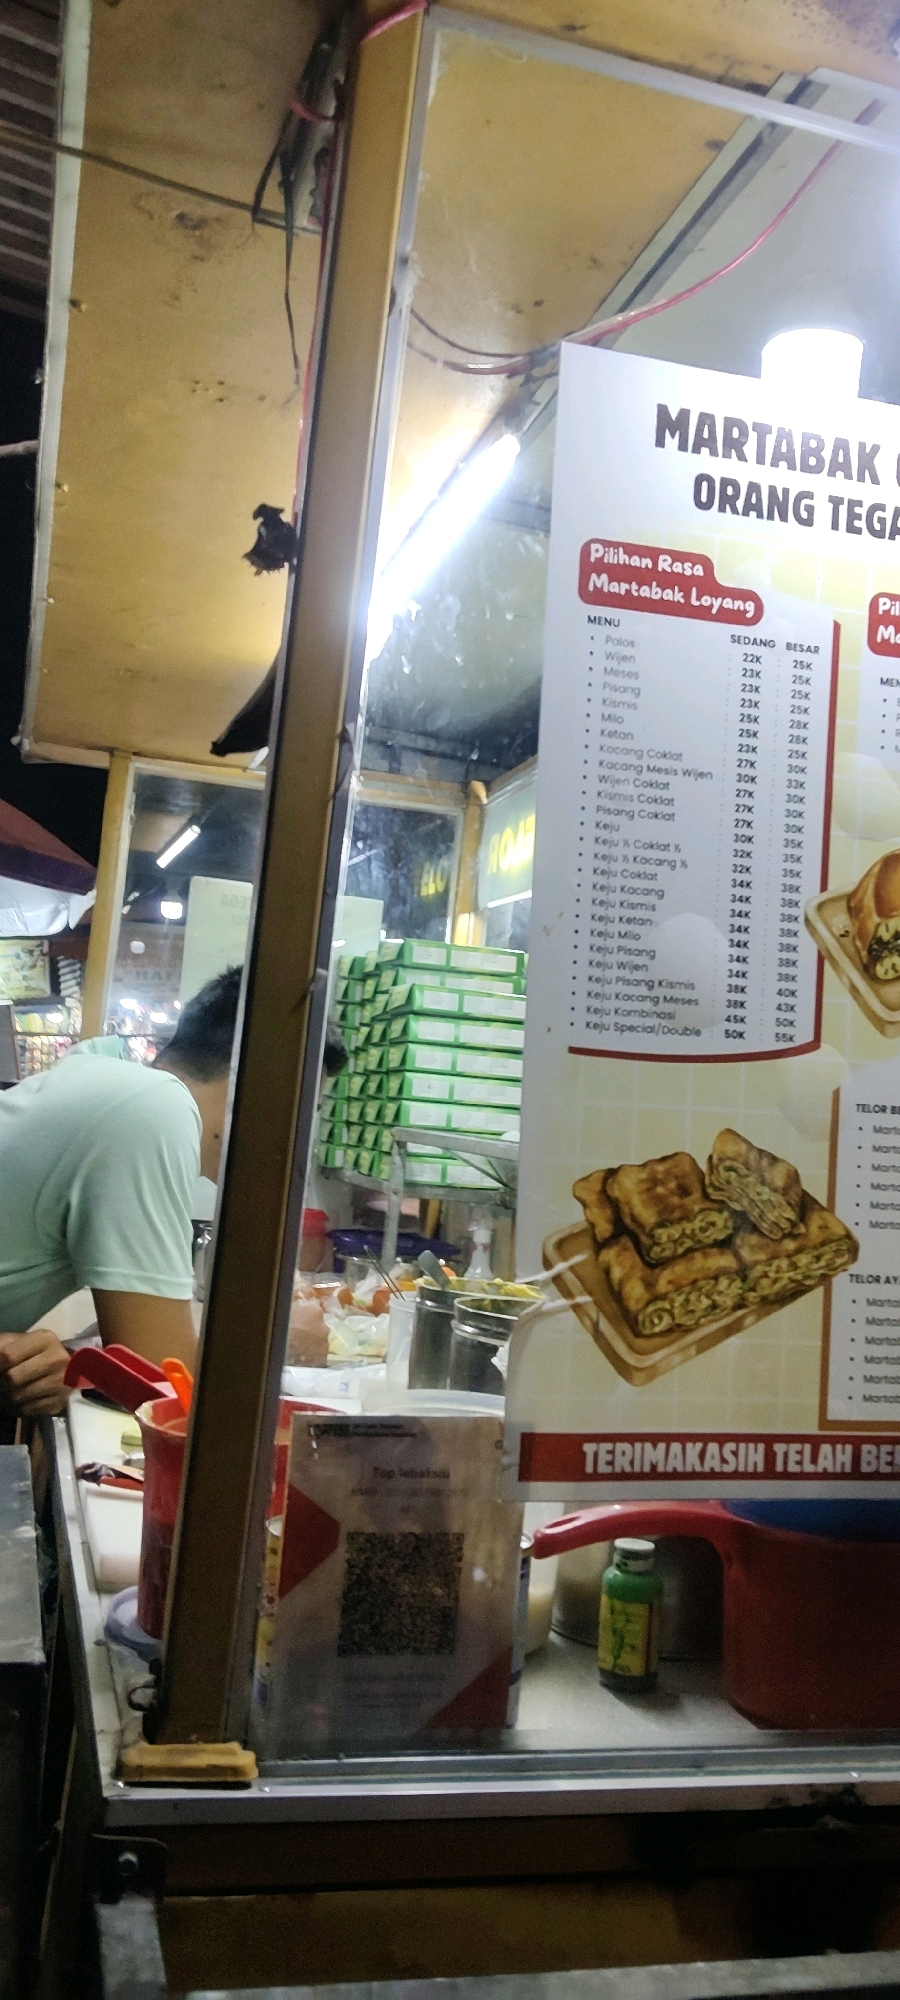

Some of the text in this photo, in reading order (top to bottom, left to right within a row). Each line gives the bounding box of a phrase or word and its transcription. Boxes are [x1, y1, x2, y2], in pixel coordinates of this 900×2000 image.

[655, 403, 881, 485] MARTABAK
[693, 472, 900, 540] ORANG TEGA
[590, 543, 704, 576] Pilihan Rasa
[589, 573, 755, 618] Martabak Loyang
[587, 615, 820, 654] MENU SEDANG BESAR
[605, 635, 812, 671] Polos 22K 25K
[604, 651, 811, 686] Wijen 23K 25K
[604, 666, 811, 700] Meses 23K 25K
[602, 682, 810, 715] Pisang 23K 25K
[601, 698, 809, 730] Kismis 25K 28K
[601, 713, 808, 745] Milo 25K 28K
[600, 728, 807, 760] Ketan 23K 25K
[600, 743, 807, 775] Kacang Coklat 27K 30K
[598, 759, 805, 790] Kacang Mesis Wijen 30K 33K
[598, 774, 805, 805] Wijen Coklat 27K 30K
[596, 804, 804, 834] Pisang Coklat 27K 30K
[597, 790, 805, 819] Kismis Coklat 27K 30K
[595, 820, 803, 849] Keju 30K 35K
[594, 836, 619, 849] Keju
[633, 841, 670, 852] Coklat
[732, 849, 752, 860] 32K
[782, 853, 802, 864] 35K
[594, 852, 618, 865] Keju
[633, 856, 677, 871] Kacang
[732, 864, 752, 875] 32K
[781, 868, 801, 879] 35K
[593, 867, 801, 894] Keju Coklat 34K 38K
[592, 882, 800, 909] Keju Kacang 34K 38K
[591, 897, 800, 924] Keju Kismis 34K 38K
[590, 913, 799, 939] Keju Ketan 34K 38K
[590, 928, 798, 954] Keju Milo 34K 38K
[588, 959, 797, 983] Keju Wijen 34K 38K
[589, 944, 798, 969] Keju Pisang 34K 38K
[587, 974, 798, 999] Keju Pisang Kismis 38K 40K
[586, 1005, 796, 1028] Keju Kombinasi 45K 50K
[587, 990, 796, 1014] Keju Kacang Meses 38K 43K
[585, 1020, 795, 1043] Keju Special/Double 50K 55K
[856, 1104, 887, 1113] TELOR
[849, 1274, 881, 1284] TELOR
[582, 1442, 765, 1475] TERIMAKASIH
[773, 1443, 852, 1474] TELAH
